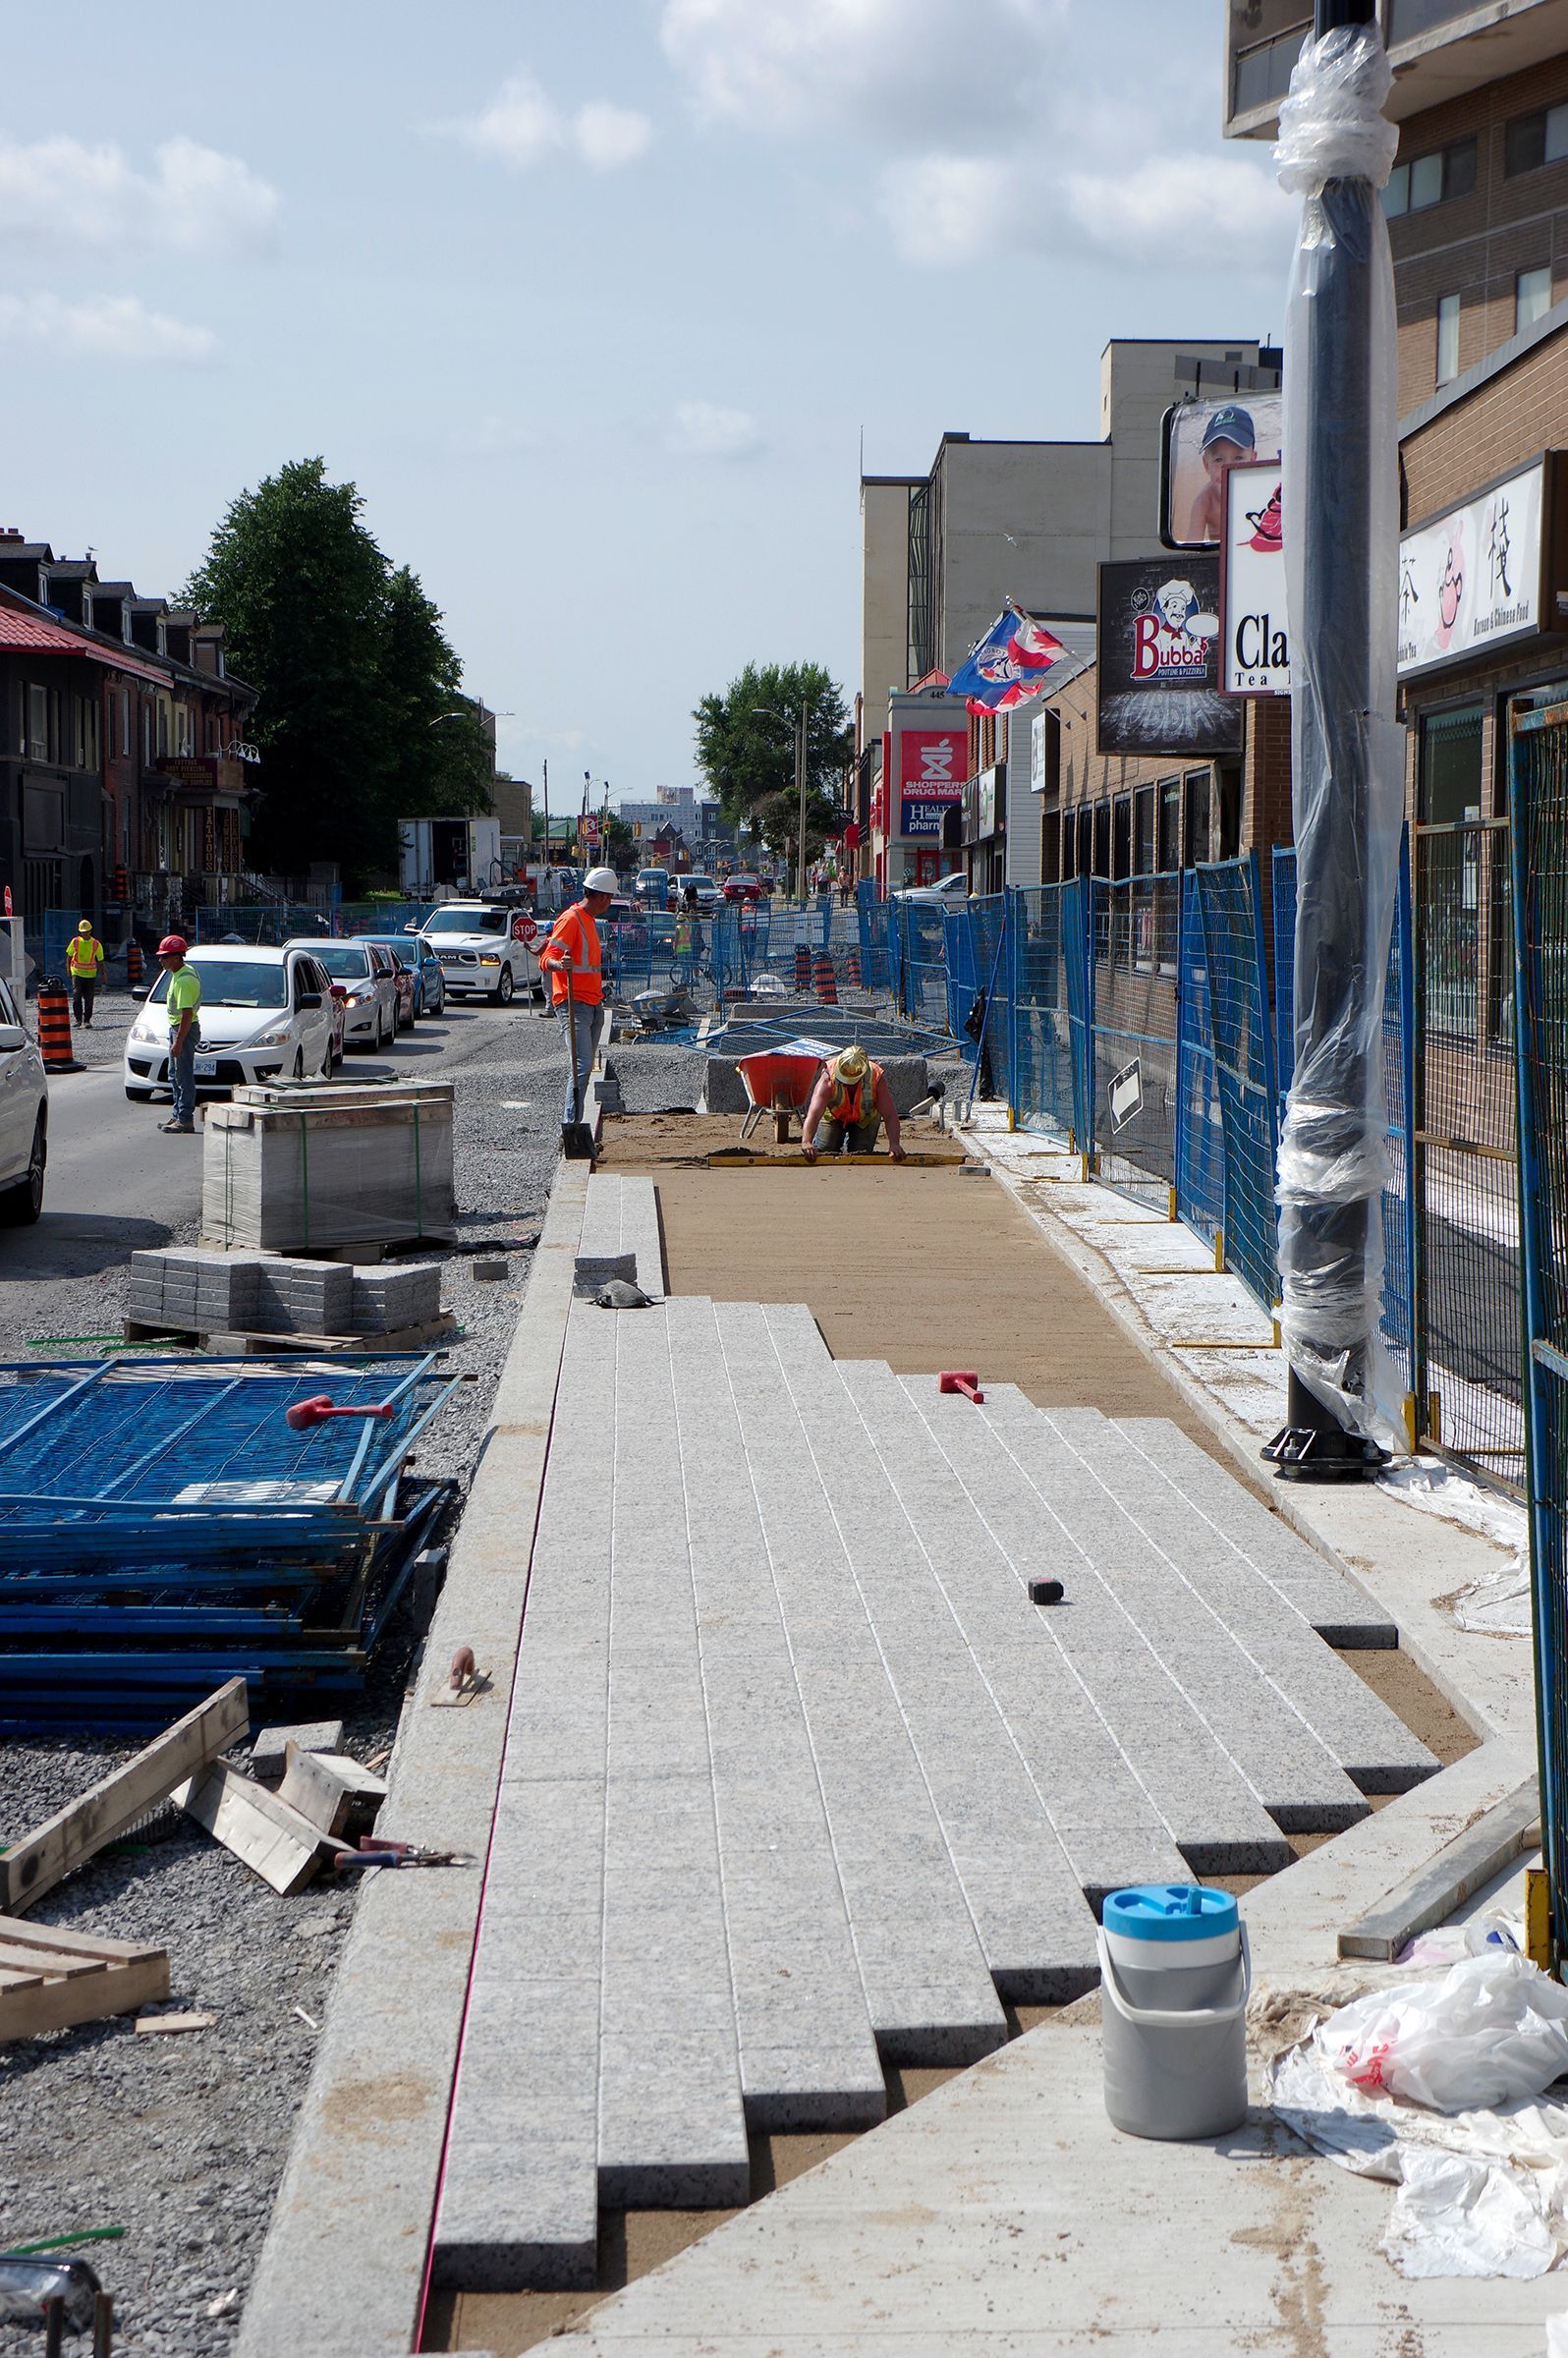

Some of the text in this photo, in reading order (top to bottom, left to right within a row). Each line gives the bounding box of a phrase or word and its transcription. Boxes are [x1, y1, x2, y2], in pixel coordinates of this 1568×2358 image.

[1494, 607, 1516, 628] Chinese
[1516, 599, 1530, 623] Food
[1236, 613, 1290, 670] Cla
[1235, 672, 1268, 687] Tea
[910, 805, 951, 820] HEALT
[514, 925, 536, 935] STOP
